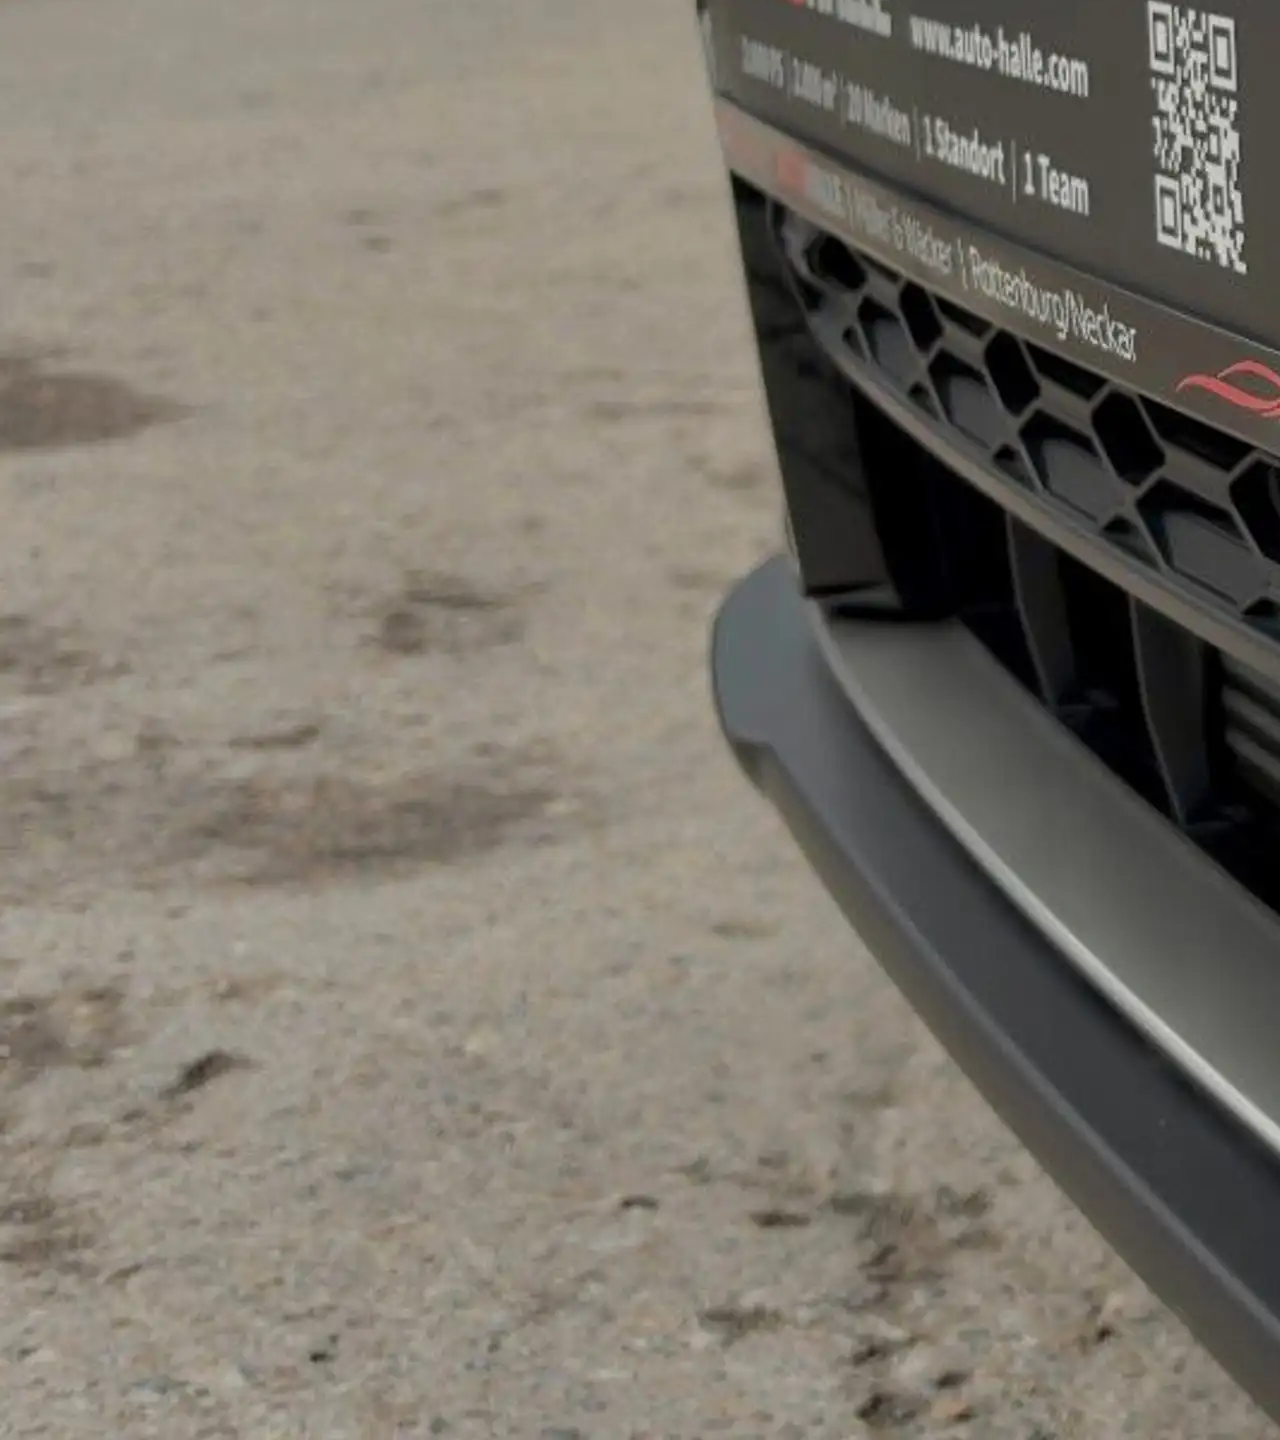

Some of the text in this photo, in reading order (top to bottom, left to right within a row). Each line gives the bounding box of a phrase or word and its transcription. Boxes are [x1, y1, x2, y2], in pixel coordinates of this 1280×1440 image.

[909, 14, 1090, 98] www.auto-halle.com
[923, 113, 935, 156] 1
[935, 116, 1006, 186] Standort
[1024, 149, 1036, 196] 1
[1037, 153, 1090, 217] Team
